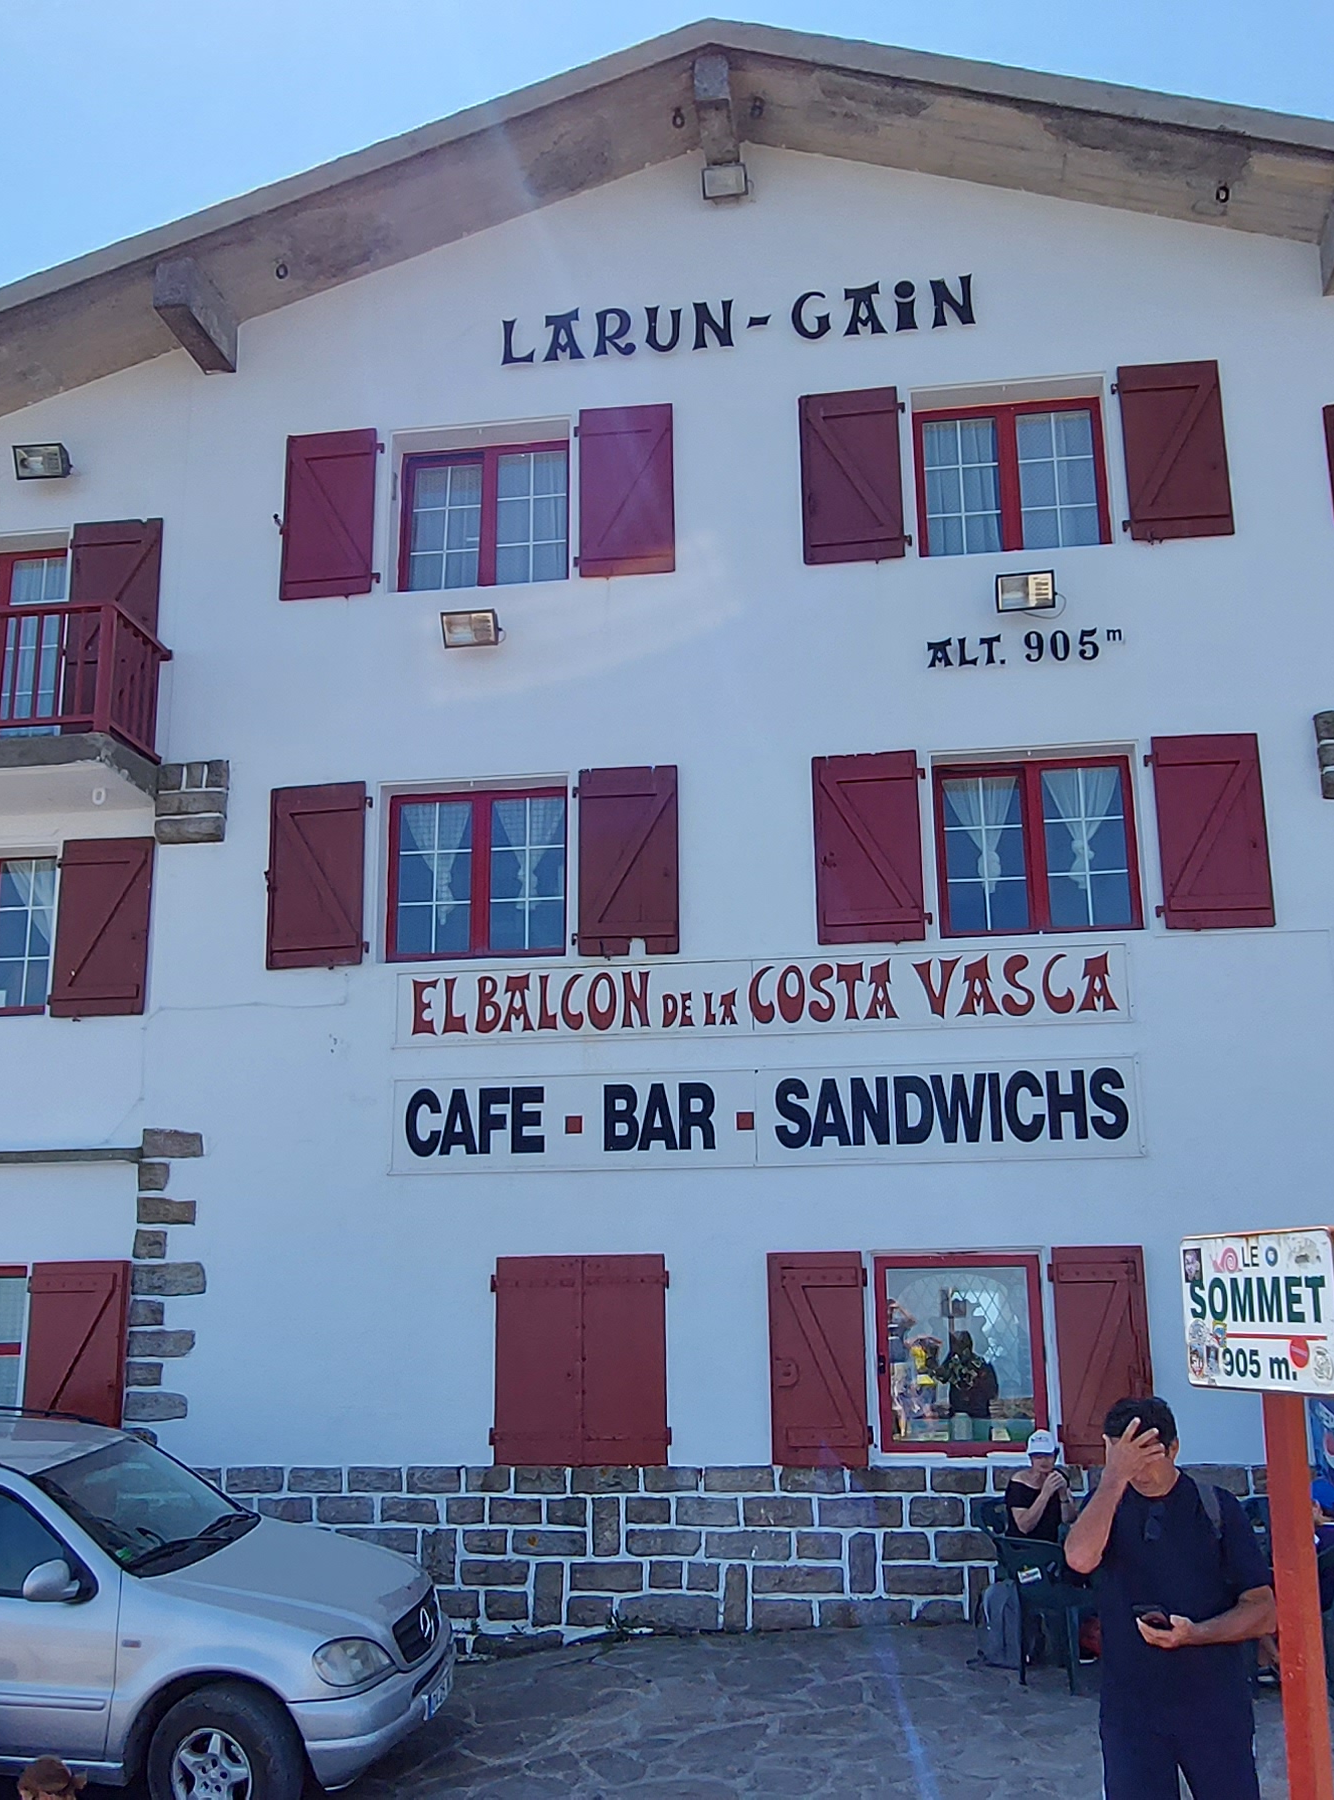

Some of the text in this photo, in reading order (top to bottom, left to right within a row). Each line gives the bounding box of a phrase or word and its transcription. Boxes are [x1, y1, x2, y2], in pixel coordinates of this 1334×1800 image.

[926, 634, 1007, 669] ALT.
[411, 950, 1121, 1036] EL BALCON DE LA COSTA VASCA
[404, 1066, 1130, 1158] CAFE BAR SANDWICHS
[1241, 1245, 1260, 1268] LE
[1189, 1275, 1326, 1324] SOMMET
[1222, 1347, 1261, 1379] 905
